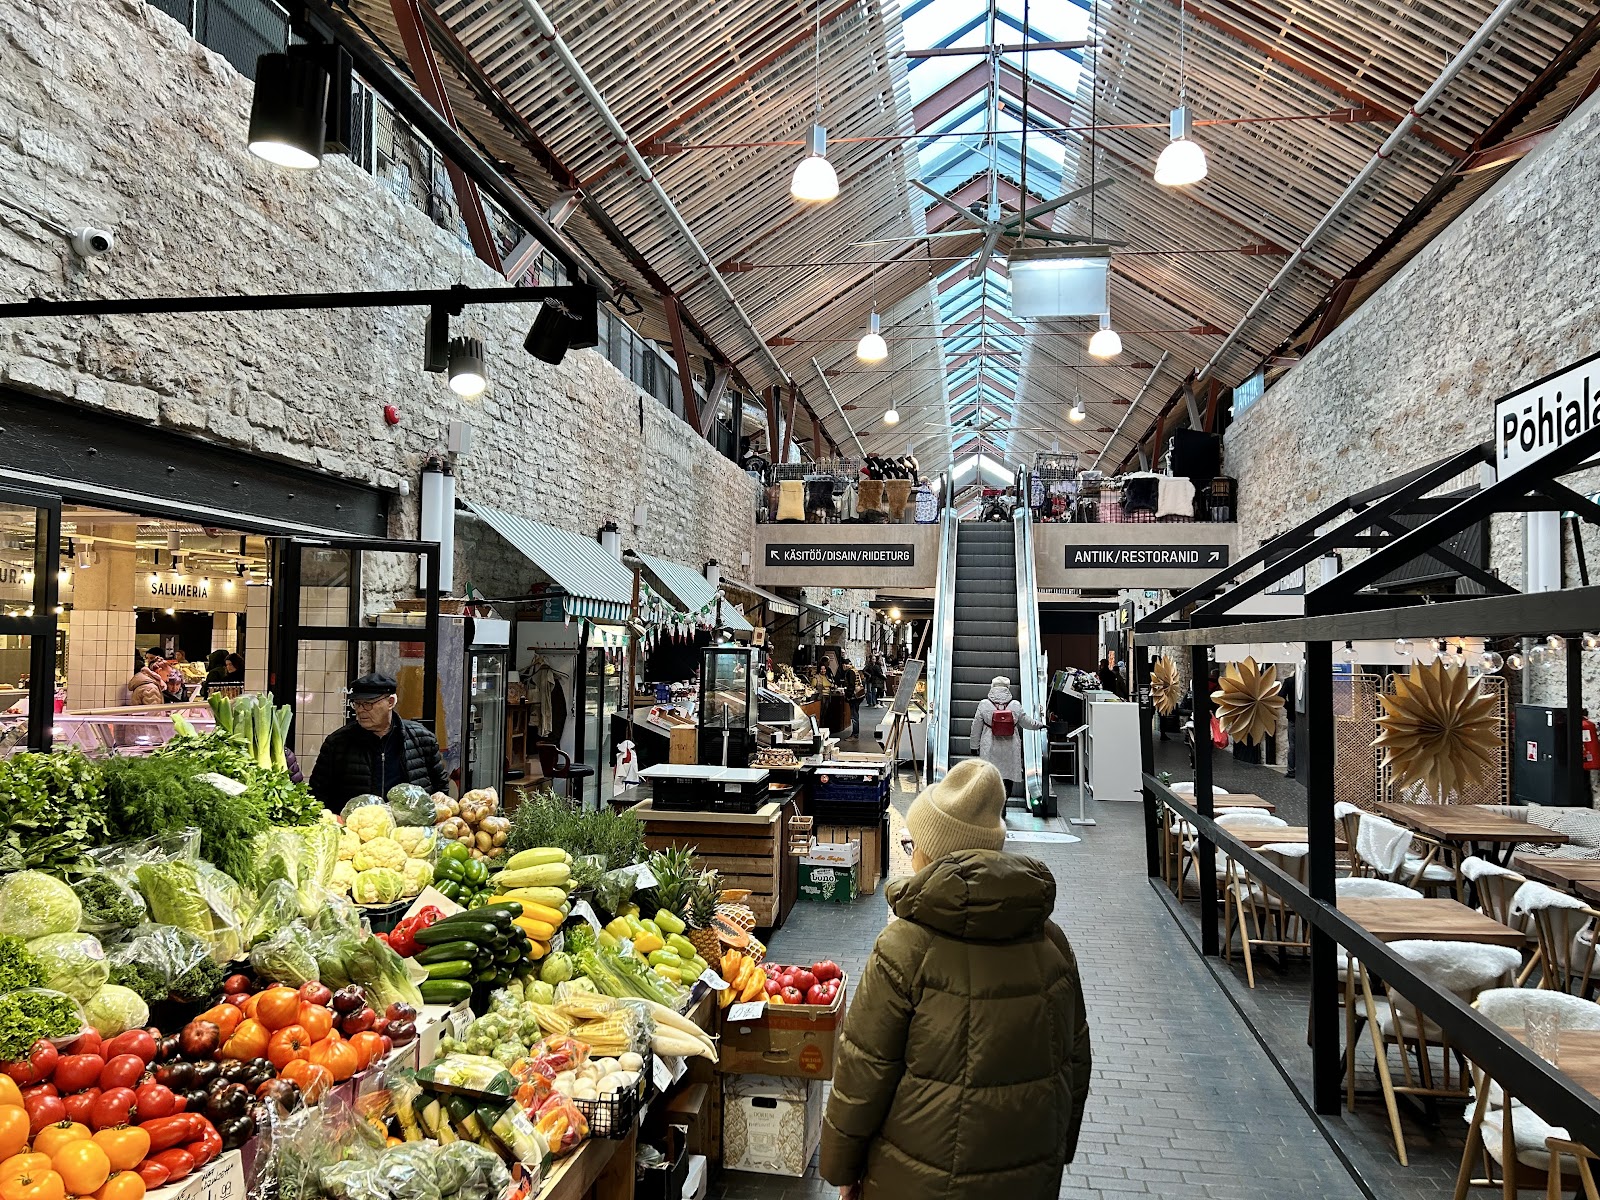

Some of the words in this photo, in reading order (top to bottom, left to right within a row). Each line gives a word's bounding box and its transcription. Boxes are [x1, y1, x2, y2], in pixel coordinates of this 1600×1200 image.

[784, 549, 910, 561] KÄSITÖÖ/DISAIN/RIIDETURG
[1074, 550, 1199, 563] ANTIIK/RESTORANID
[151, 582, 208, 598] SALUMERIA
[812, 873, 835, 882] bono
